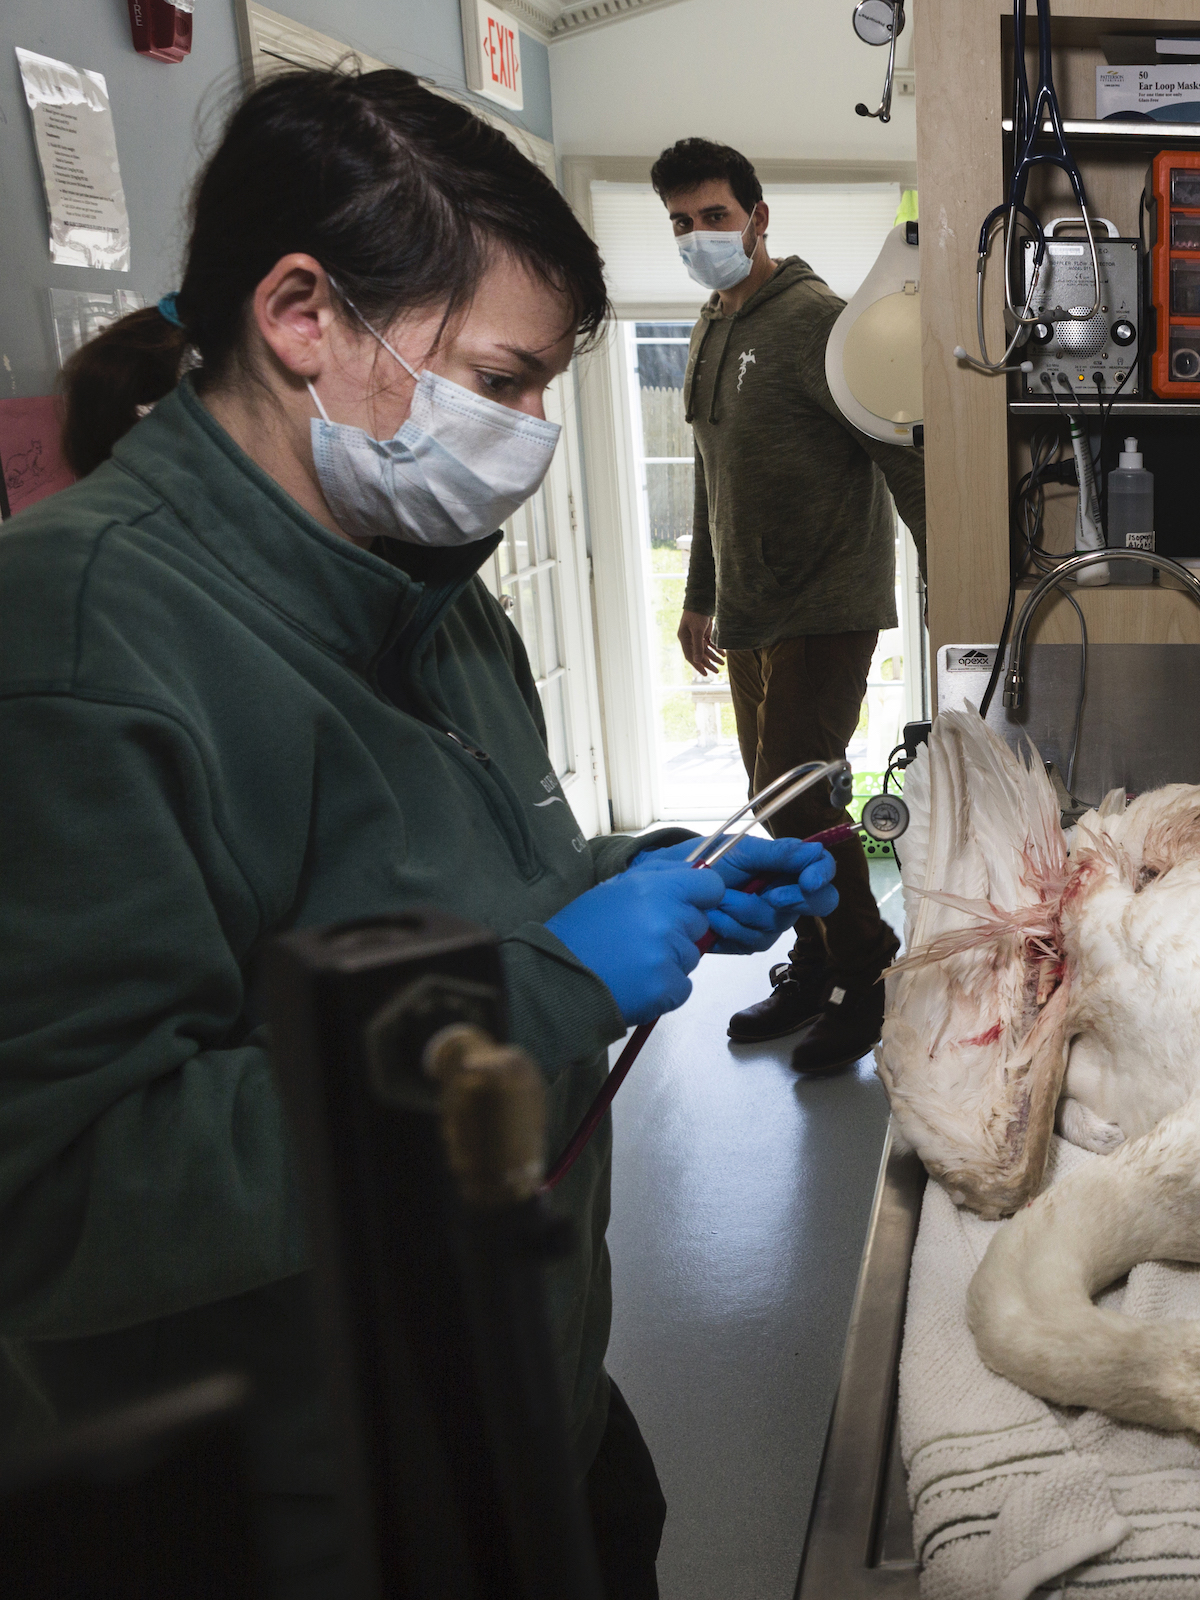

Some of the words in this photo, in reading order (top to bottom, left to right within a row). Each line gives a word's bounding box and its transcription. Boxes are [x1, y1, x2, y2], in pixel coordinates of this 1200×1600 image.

[487, 16, 517, 92] EXIT
[1138, 71, 1149, 80] 50
[1138, 82, 1154, 91] Ear
[1155, 81, 1176, 93] Loop
[958, 658, 989, 666] apexx
